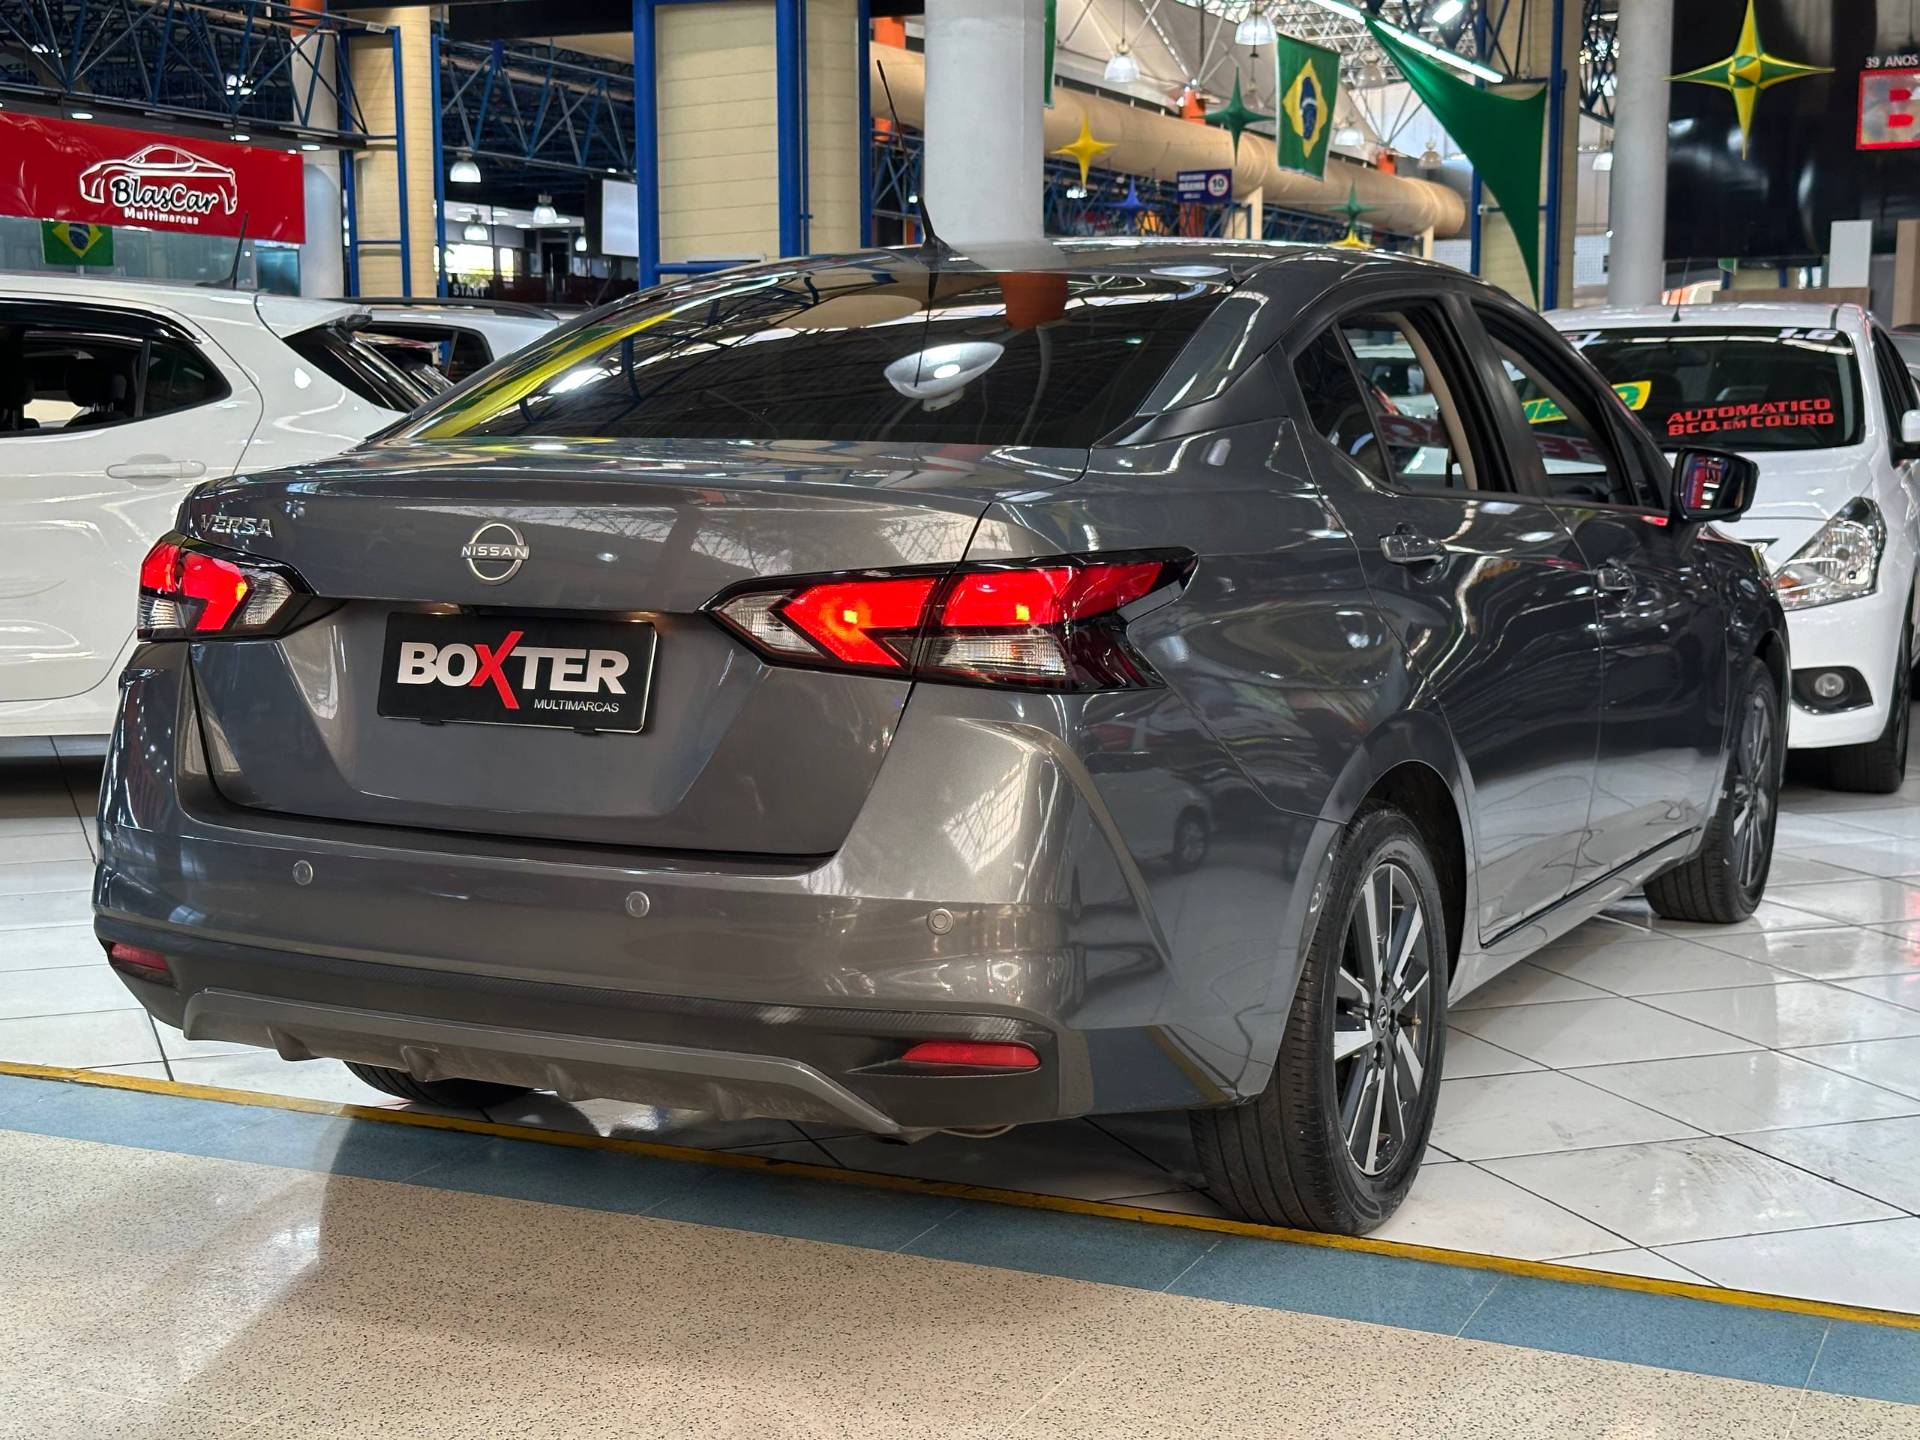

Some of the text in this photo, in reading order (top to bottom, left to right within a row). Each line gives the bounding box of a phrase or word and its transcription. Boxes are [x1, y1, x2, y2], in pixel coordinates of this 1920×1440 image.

[1865, 55, 1919, 68] 39 ANOS
[110, 174, 220, 215] BlasCar
[1667, 398, 1831, 425] AUTOMATICO
[1723, 418, 1747, 430] EM
[1750, 411, 1834, 428] COURO
[201, 514, 273, 538] VERSA
[461, 545, 527, 558] NISSAN
[397, 631, 629, 710] BOXTER
[533, 698, 620, 713] MULTIMARCAS
